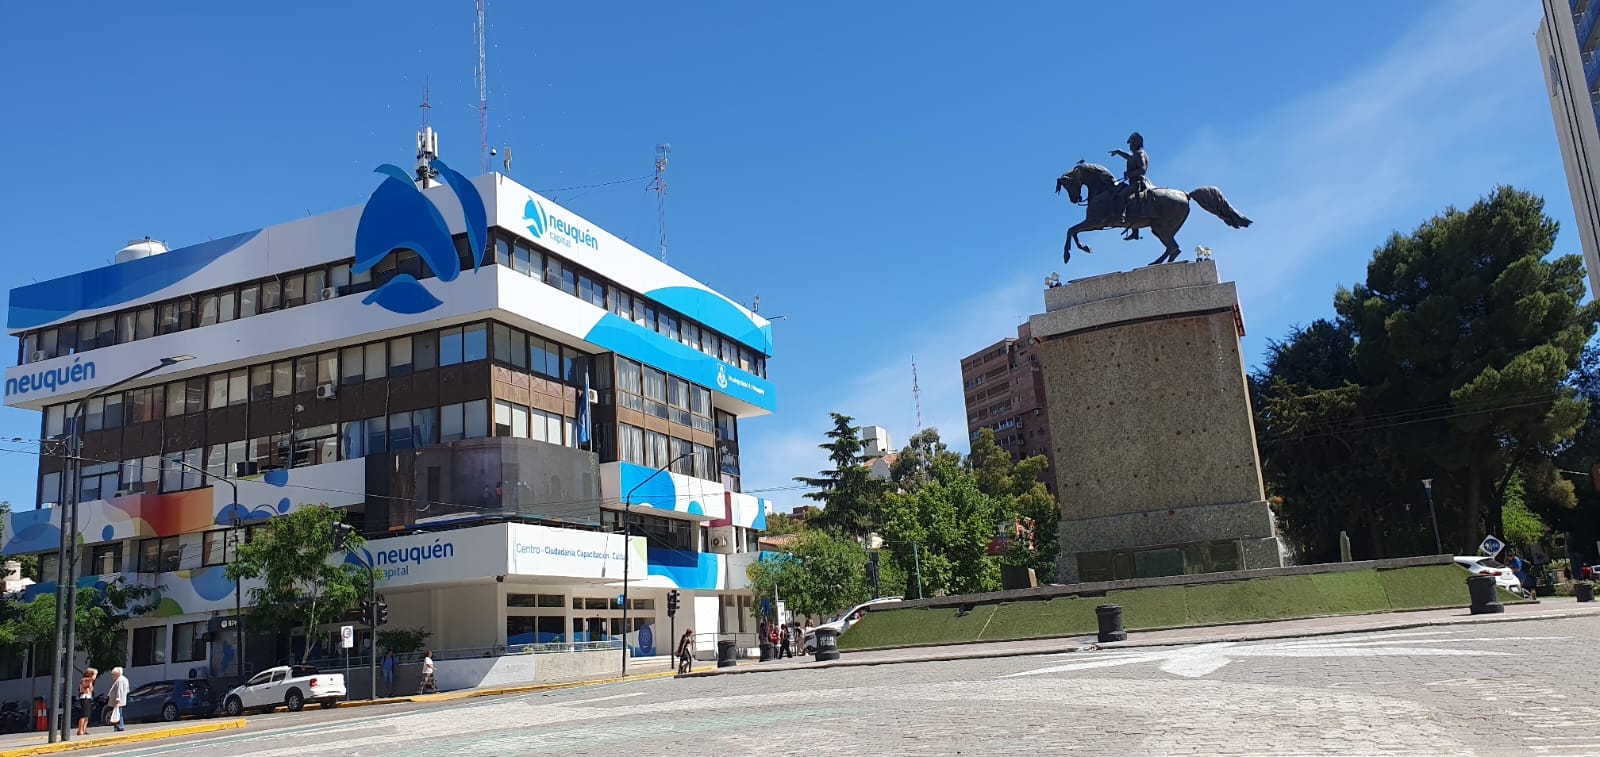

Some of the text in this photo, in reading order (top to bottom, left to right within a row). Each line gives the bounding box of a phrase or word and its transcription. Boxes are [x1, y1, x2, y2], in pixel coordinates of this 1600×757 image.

[549, 214, 598, 250] neuquén
[549, 231, 571, 248] capital
[5, 356, 96, 396] neuquén
[377, 538, 454, 566] neuquén
[516, 543, 540, 554] Centro
[382, 564, 409, 580] apital
